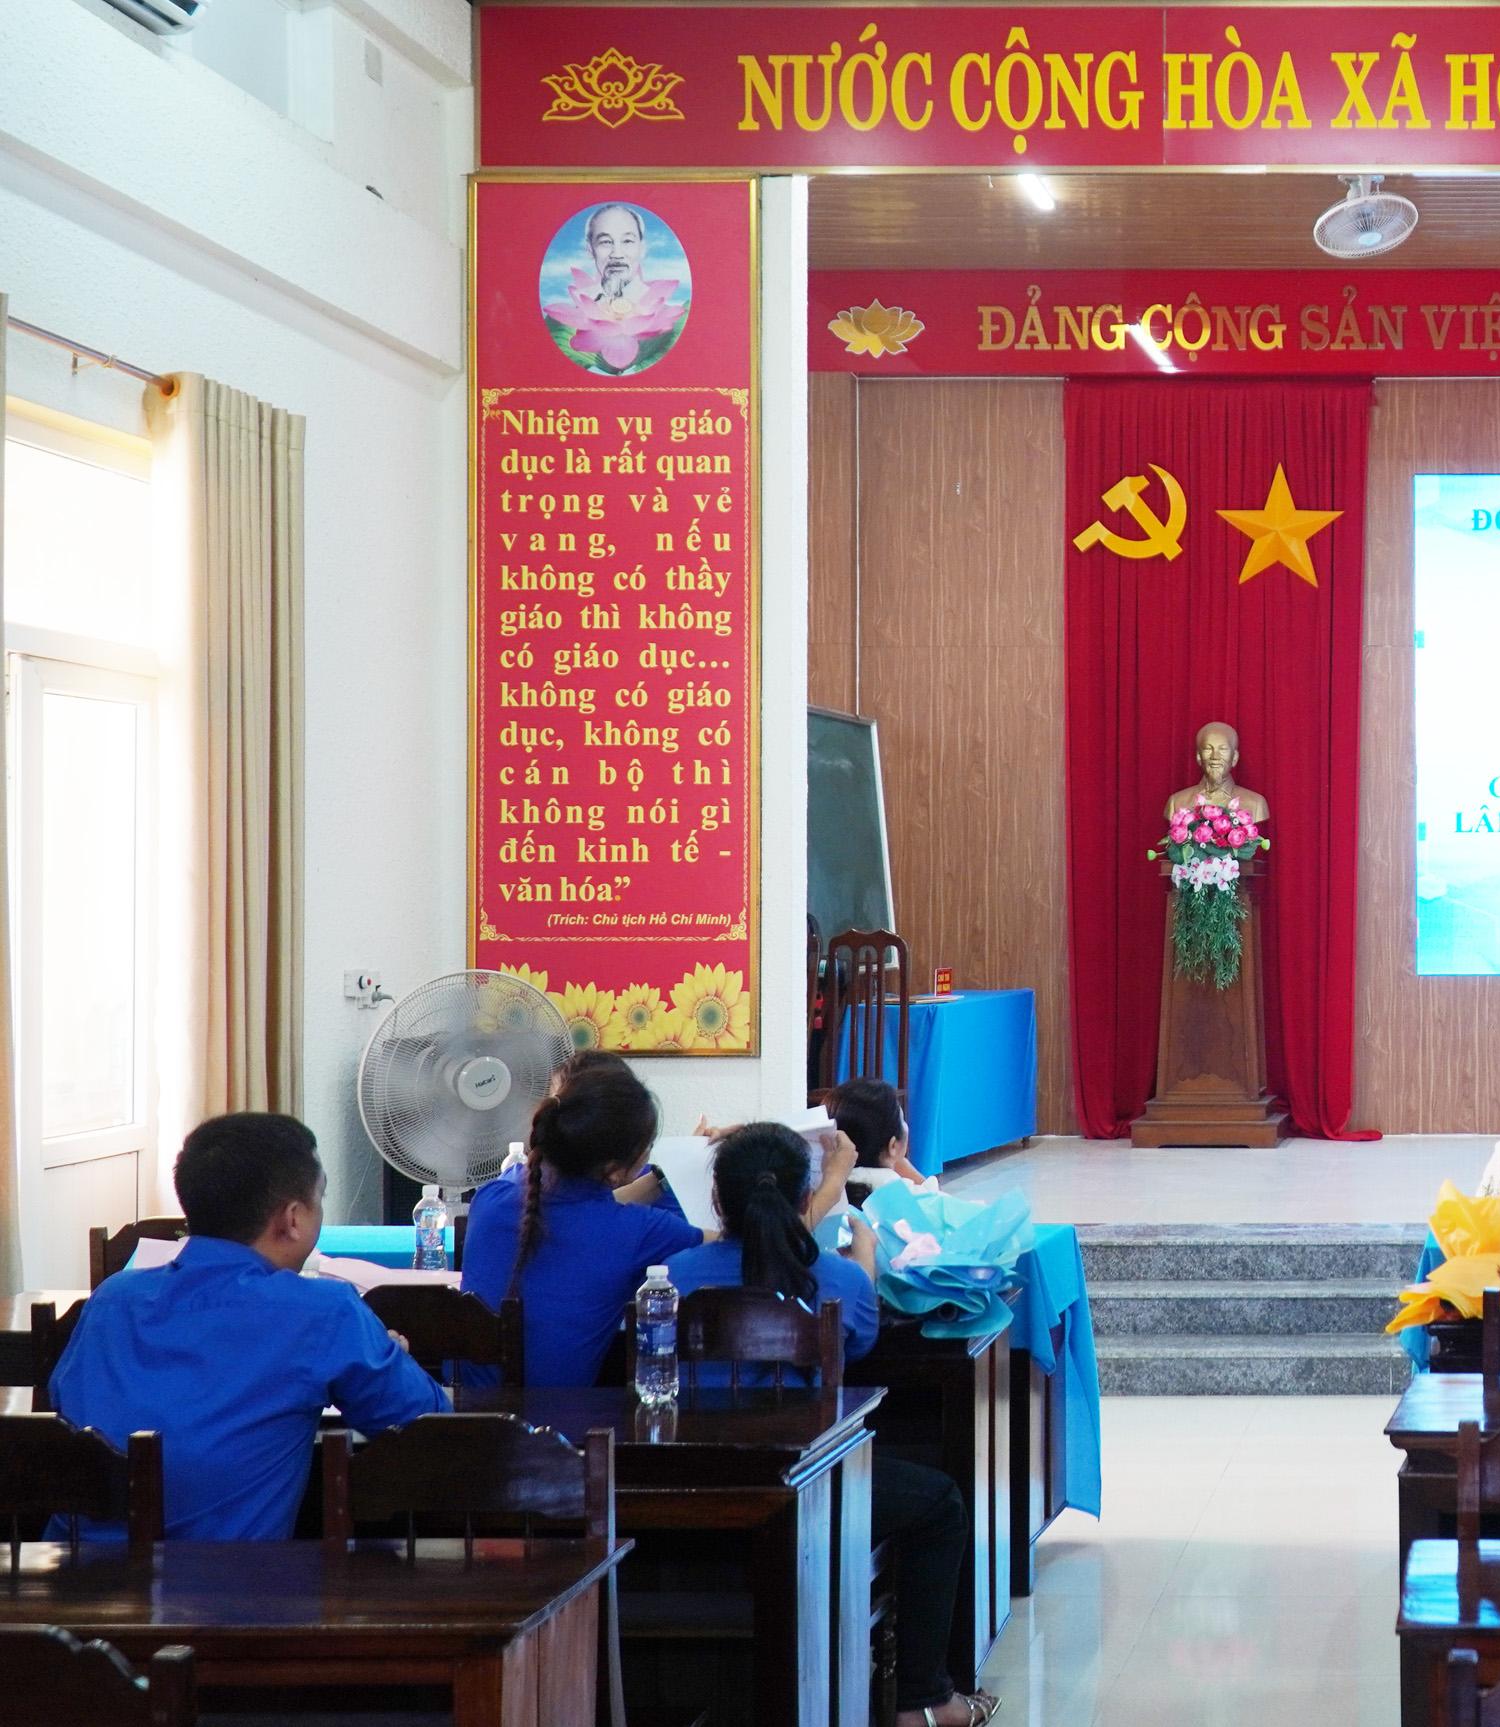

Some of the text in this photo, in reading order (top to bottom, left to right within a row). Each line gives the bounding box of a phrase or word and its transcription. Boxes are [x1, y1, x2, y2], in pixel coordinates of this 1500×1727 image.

[739, 24, 933, 132] NƯỚC
[950, 28, 1144, 154] CỘNG
[1163, 26, 1313, 131] HÒA
[1330, 33, 1431, 131] XÃ
[976, 284, 1129, 353] ĐẢNG
[1138, 293, 1288, 361] CỘNG
[1300, 286, 1408, 352] SẢN
[617, 409, 732, 442] vụ giáo
[501, 441, 731, 481] dục là rất quan
[501, 487, 732, 519] trọng và vẻ
[501, 518, 731, 558] vang, nếu
[502, 557, 731, 597] không có thầy
[501, 603, 732, 636] giáo thì không
[501, 643, 533, 668] có
[554, 643, 618, 675] giáo
[501, 681, 731, 714] không có giáo
[500, 720, 731, 753] dục, không có
[500, 759, 731, 791] cán bộ thì
[501, 798, 730, 830] không nói gì
[500, 830, 699, 863] đến kinh tế
[500, 877, 551, 901] văn
[548, 912, 731, 927] (Trích: Chủ tịch Hồ Chí Minh)
